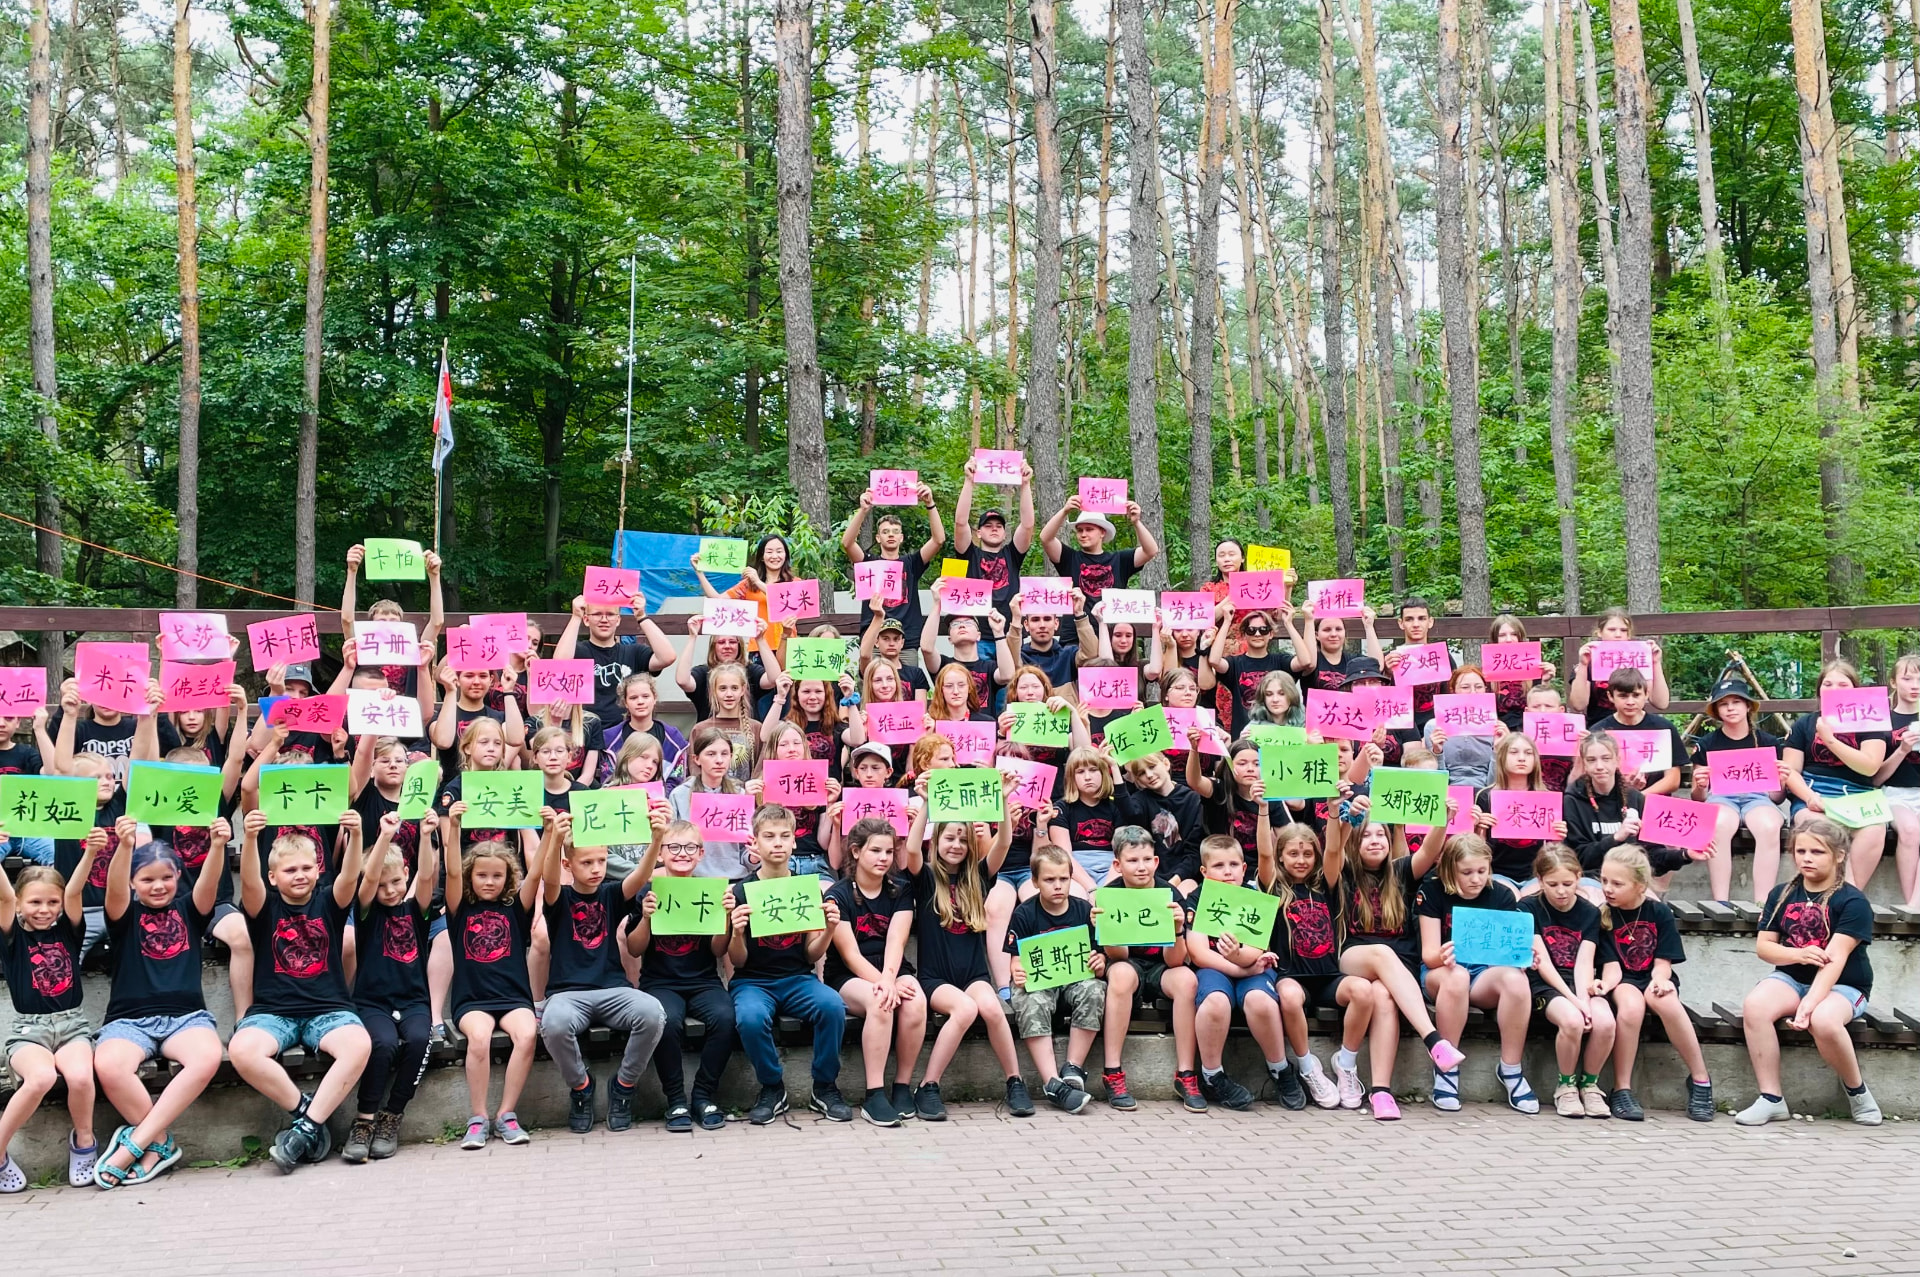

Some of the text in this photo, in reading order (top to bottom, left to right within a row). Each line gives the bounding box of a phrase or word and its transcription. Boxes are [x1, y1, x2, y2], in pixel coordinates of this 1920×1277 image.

[876, 477, 909, 498] 范特
[1086, 486, 1116, 507] 索斯
[371, 548, 413, 570] 卡帕
[706, 551, 739, 568] 我是
[594, 579, 632, 598] 马太
[859, 568, 896, 592] 叶高
[780, 590, 814, 613] 艾米
[1169, 599, 1208, 621] 劳拉
[711, 607, 751, 628] 莎塔
[452, 636, 500, 662] 卡莎
[790, 645, 844, 675] 李亚娜
[93, 665, 137, 698] 米卡
[171, 675, 226, 699] 佛兰克
[537, 671, 584, 698] 欧娜
[1088, 679, 1132, 698] 优雅
[284, 702, 331, 723] 西蒙
[361, 703, 410, 727] 安特
[878, 714, 915, 733] 维亚
[1318, 701, 1367, 731] 苏达
[1835, 703, 1883, 723] 阿达
[1108, 719, 1159, 754] 佐莎
[1534, 720, 1577, 745] 库巴
[778, 772, 818, 795] 可雅
[1271, 757, 1333, 785] 小雅
[1723, 762, 1768, 782] 西雅
[145, 786, 201, 815] 小爱
[273, 781, 332, 810] 卡卡
[404, 776, 429, 805] 奥
[472, 785, 533, 818] 安美
[933, 778, 1002, 811] 爱丽斯
[581, 799, 635, 833] 尼卡
[1381, 788, 1440, 821] 娜娜
[701, 807, 749, 832] 佑雅
[1591, 821, 1622, 835] PUM
[1655, 810, 1699, 837] 佐莎
[657, 890, 715, 923] 小卡
[761, 892, 815, 923] 安安
[1110, 908, 1159, 926] 小巴
[1206, 898, 1262, 936] 安迪
[1028, 942, 1090, 983] 奥斯卡
